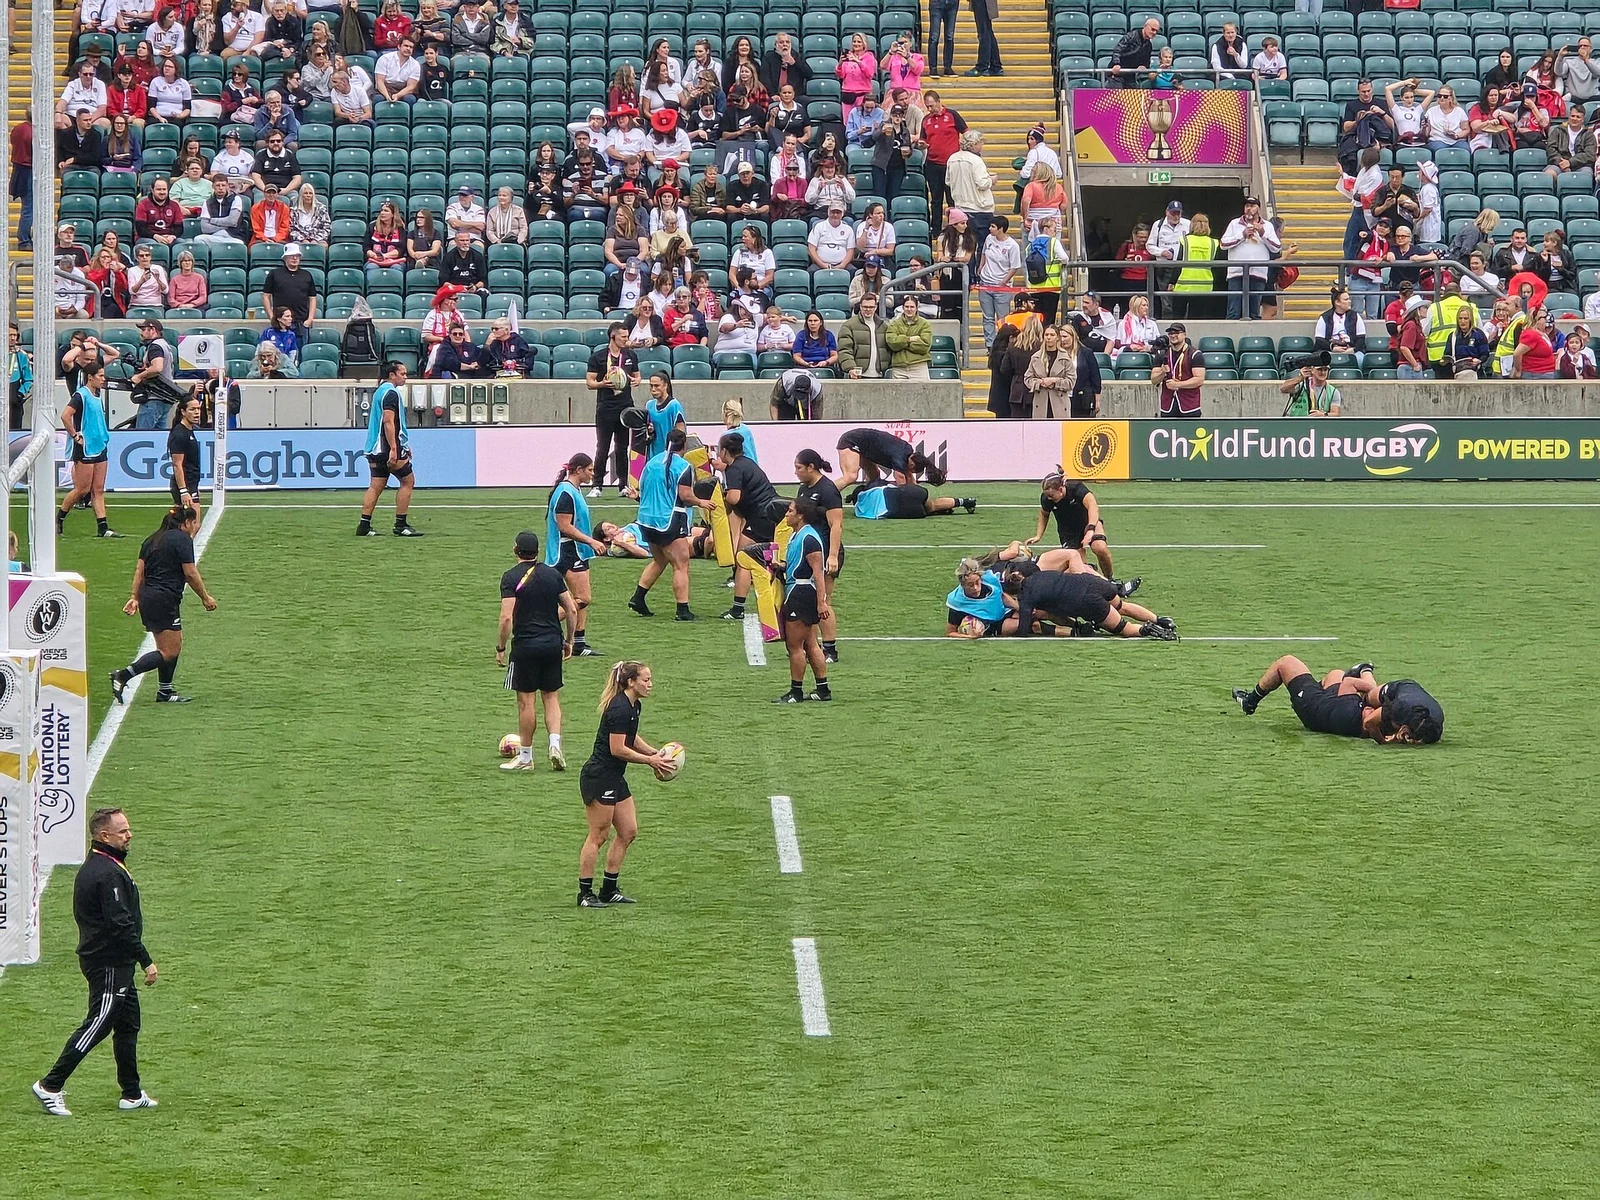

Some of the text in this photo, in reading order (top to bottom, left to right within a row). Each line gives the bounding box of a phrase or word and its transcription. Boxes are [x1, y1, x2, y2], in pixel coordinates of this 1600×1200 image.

[119, 440, 366, 485] Galagher
[1323, 437, 1428, 458] RUGBY
[1458, 439, 1571, 460] POWERED
[41, 702, 54, 785] NATIONAL
[57, 712, 70, 785] LOTTERY
